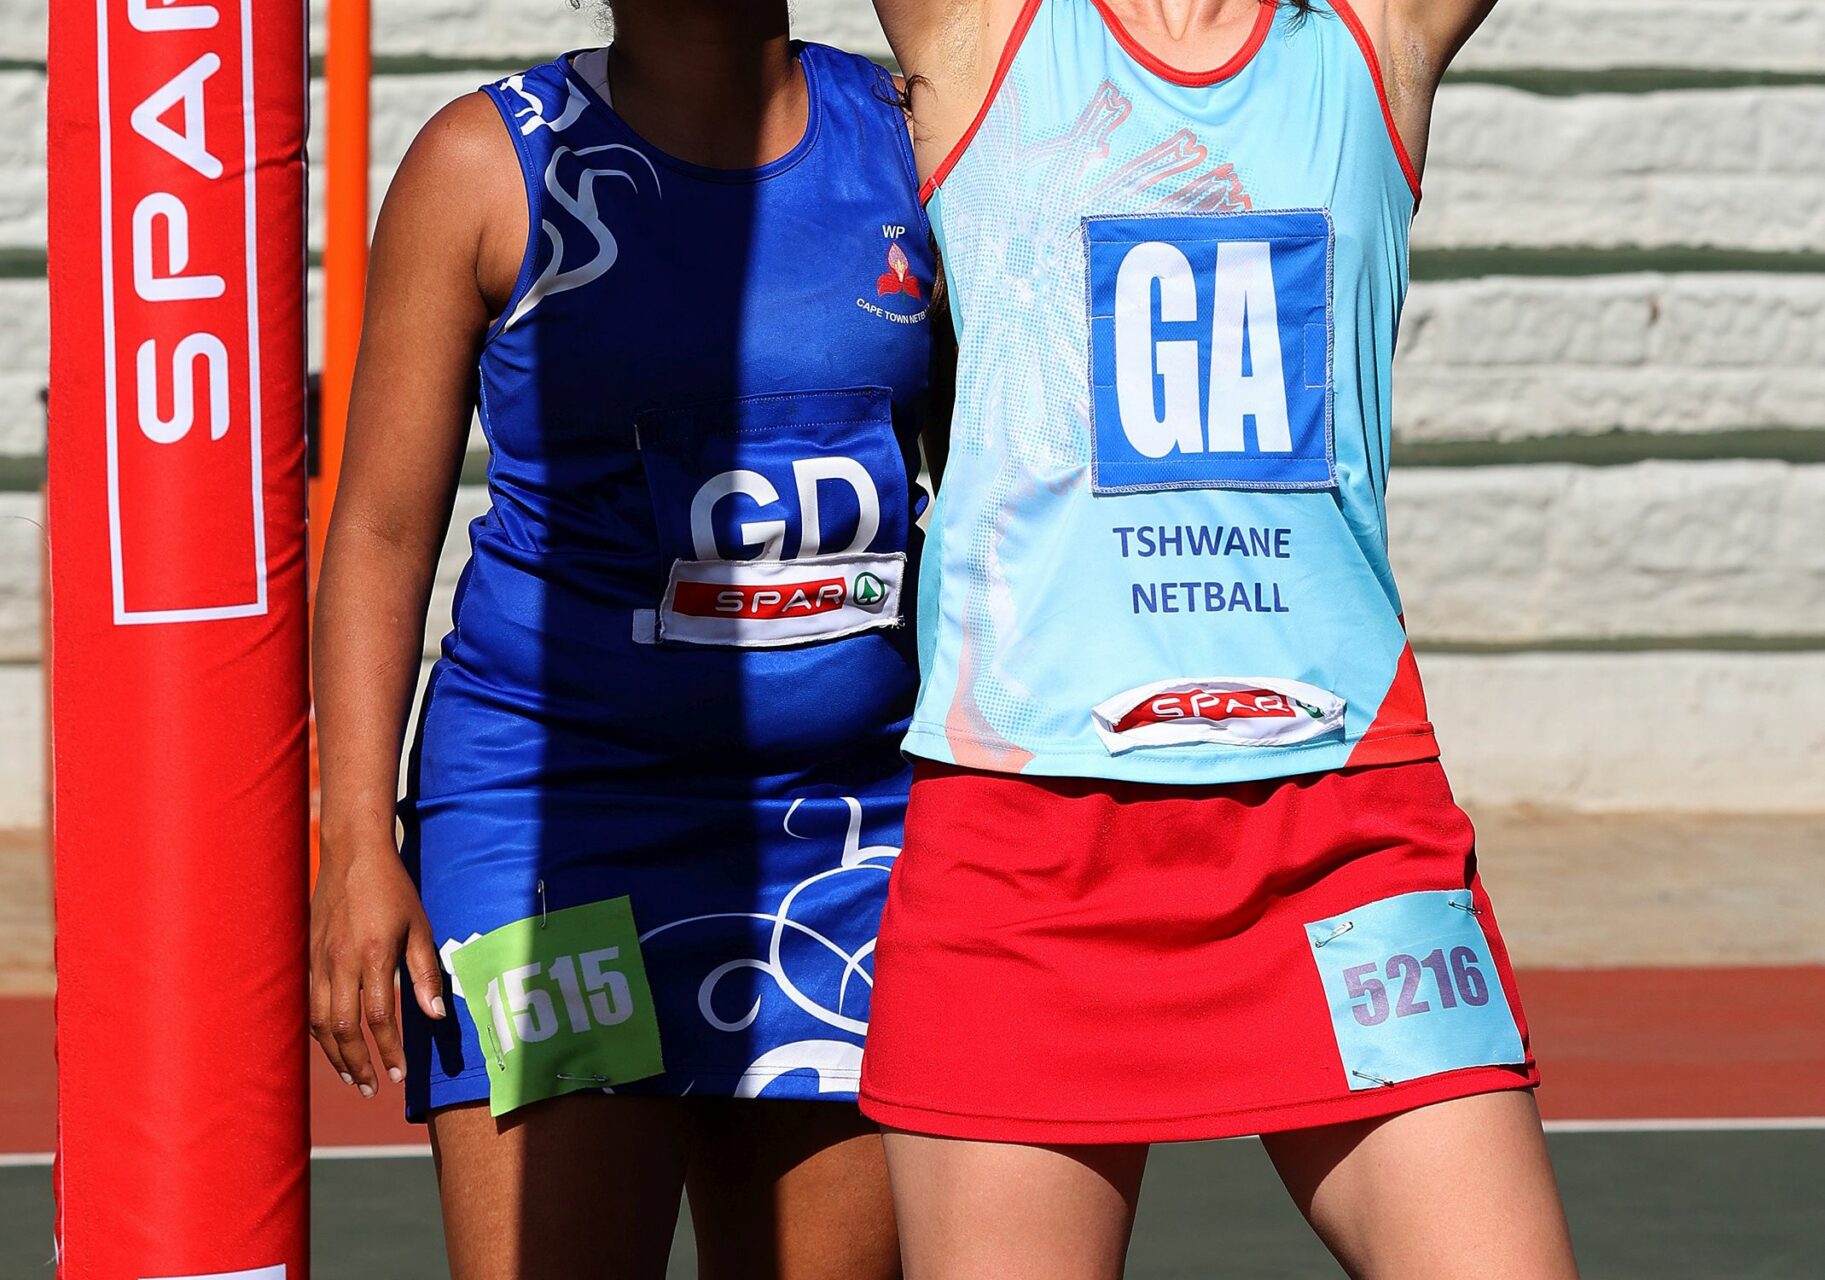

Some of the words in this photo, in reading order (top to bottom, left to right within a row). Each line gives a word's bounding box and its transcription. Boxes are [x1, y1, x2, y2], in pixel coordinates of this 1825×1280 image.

[882, 224, 906, 239] WP
[856, 298, 883, 318] CAPE
[884, 310, 909, 324] TOWN
[909, 305, 930, 324] NETB
[1115, 241, 1293, 459] GA
[690, 456, 880, 561] GD
[1112, 525, 1292, 559] TSHWANE
[715, 584, 844, 613] SPAR
[1131, 581, 1290, 614] NETBALL
[1151, 693, 1290, 718] SPAR
[485, 946, 634, 1055] 1515
[1342, 946, 1489, 1027] 5216
